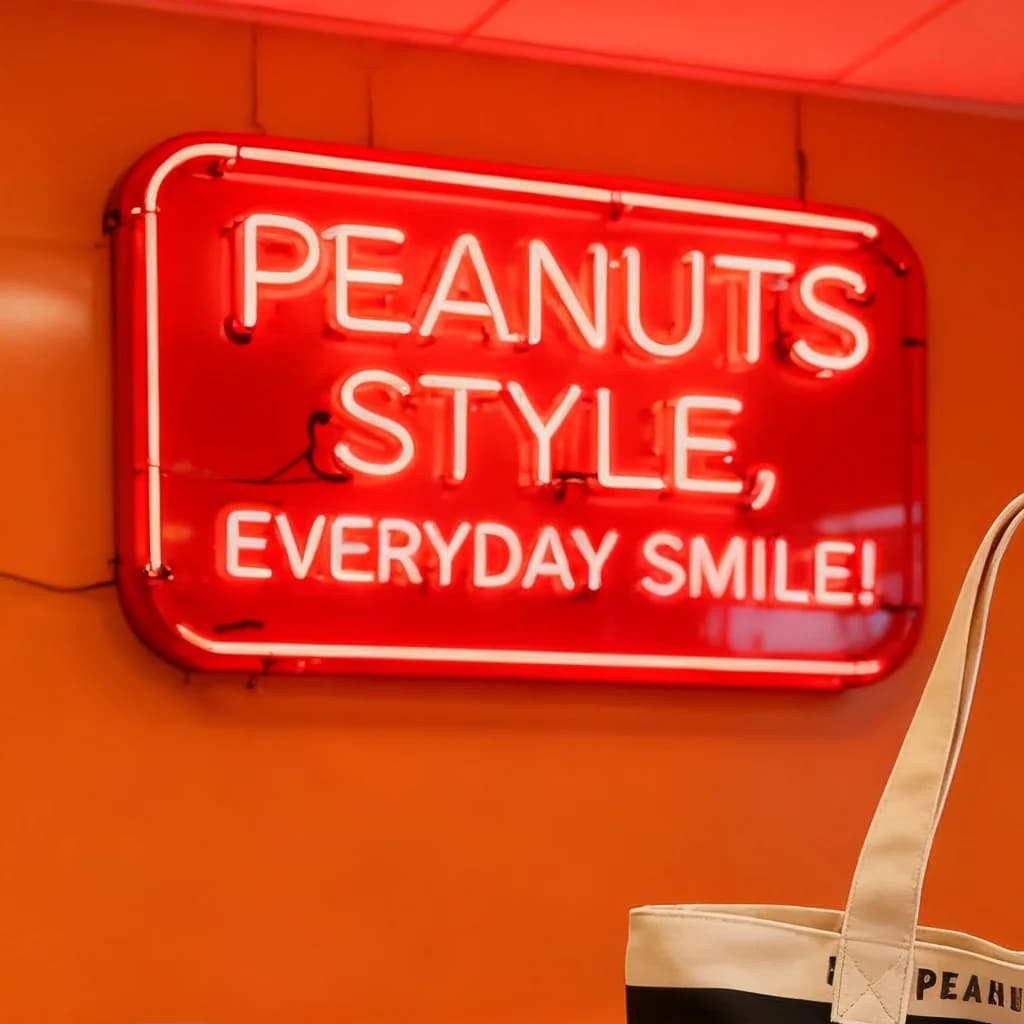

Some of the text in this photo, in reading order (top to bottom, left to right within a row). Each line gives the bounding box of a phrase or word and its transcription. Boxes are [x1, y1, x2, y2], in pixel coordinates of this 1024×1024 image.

[240, 213, 871, 373] PEANUTS
[333, 370, 777, 510] STYLE,
[224, 510, 878, 606] EVERYDAY SMILE!
